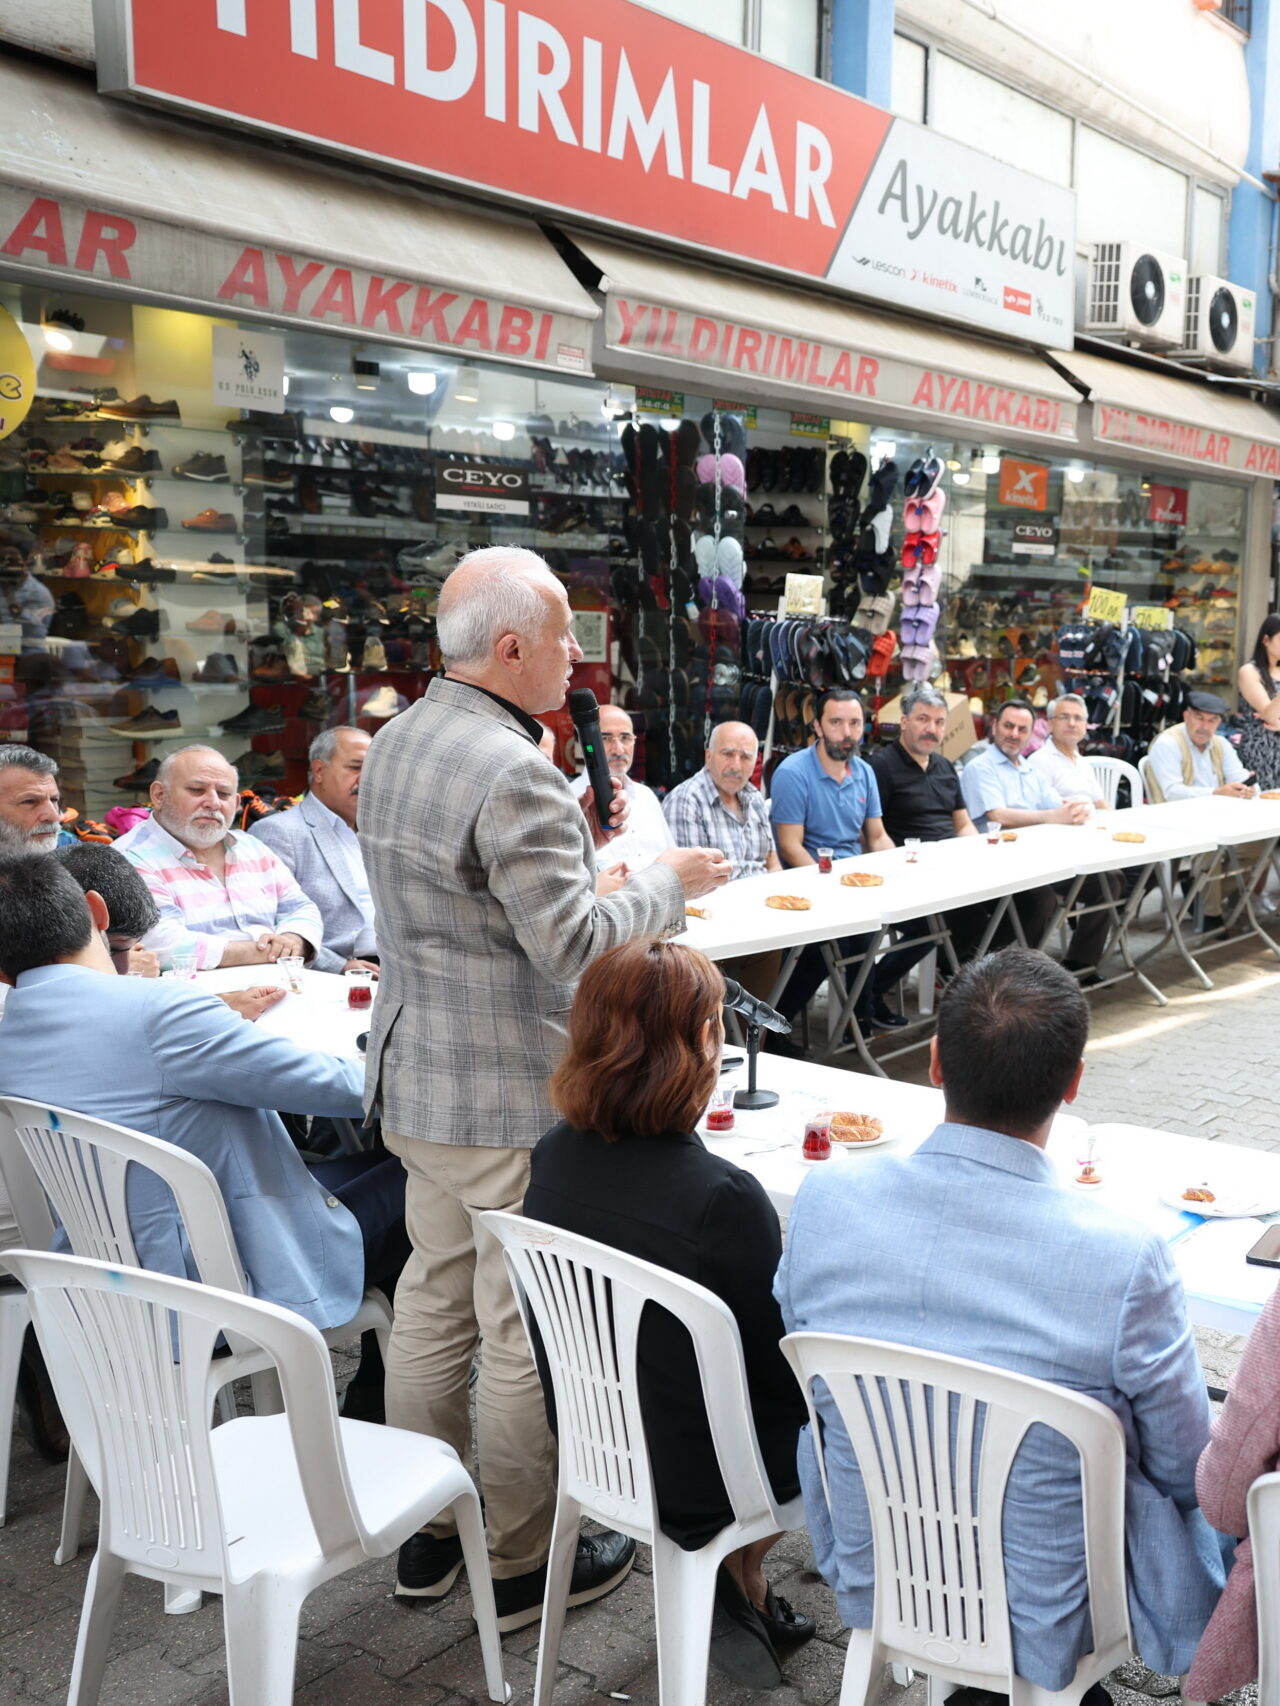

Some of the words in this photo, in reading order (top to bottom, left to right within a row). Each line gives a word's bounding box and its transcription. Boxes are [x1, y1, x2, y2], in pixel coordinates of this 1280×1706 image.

[217, 0, 837, 229] LDIRIMLAR
[877, 158, 1066, 277] Ayakkabı
[217, 247, 554, 361] AYAKKABI
[922, 272, 959, 294] kinetix
[614, 299, 880, 397] YILDIRIMLAR
[912, 371, 1061, 434] AYAKKABI
[442, 467, 523, 489] CEYO
[1101, 406, 1232, 464] YILDIRIMLAR
[1015, 525, 1053, 538] CEYO
